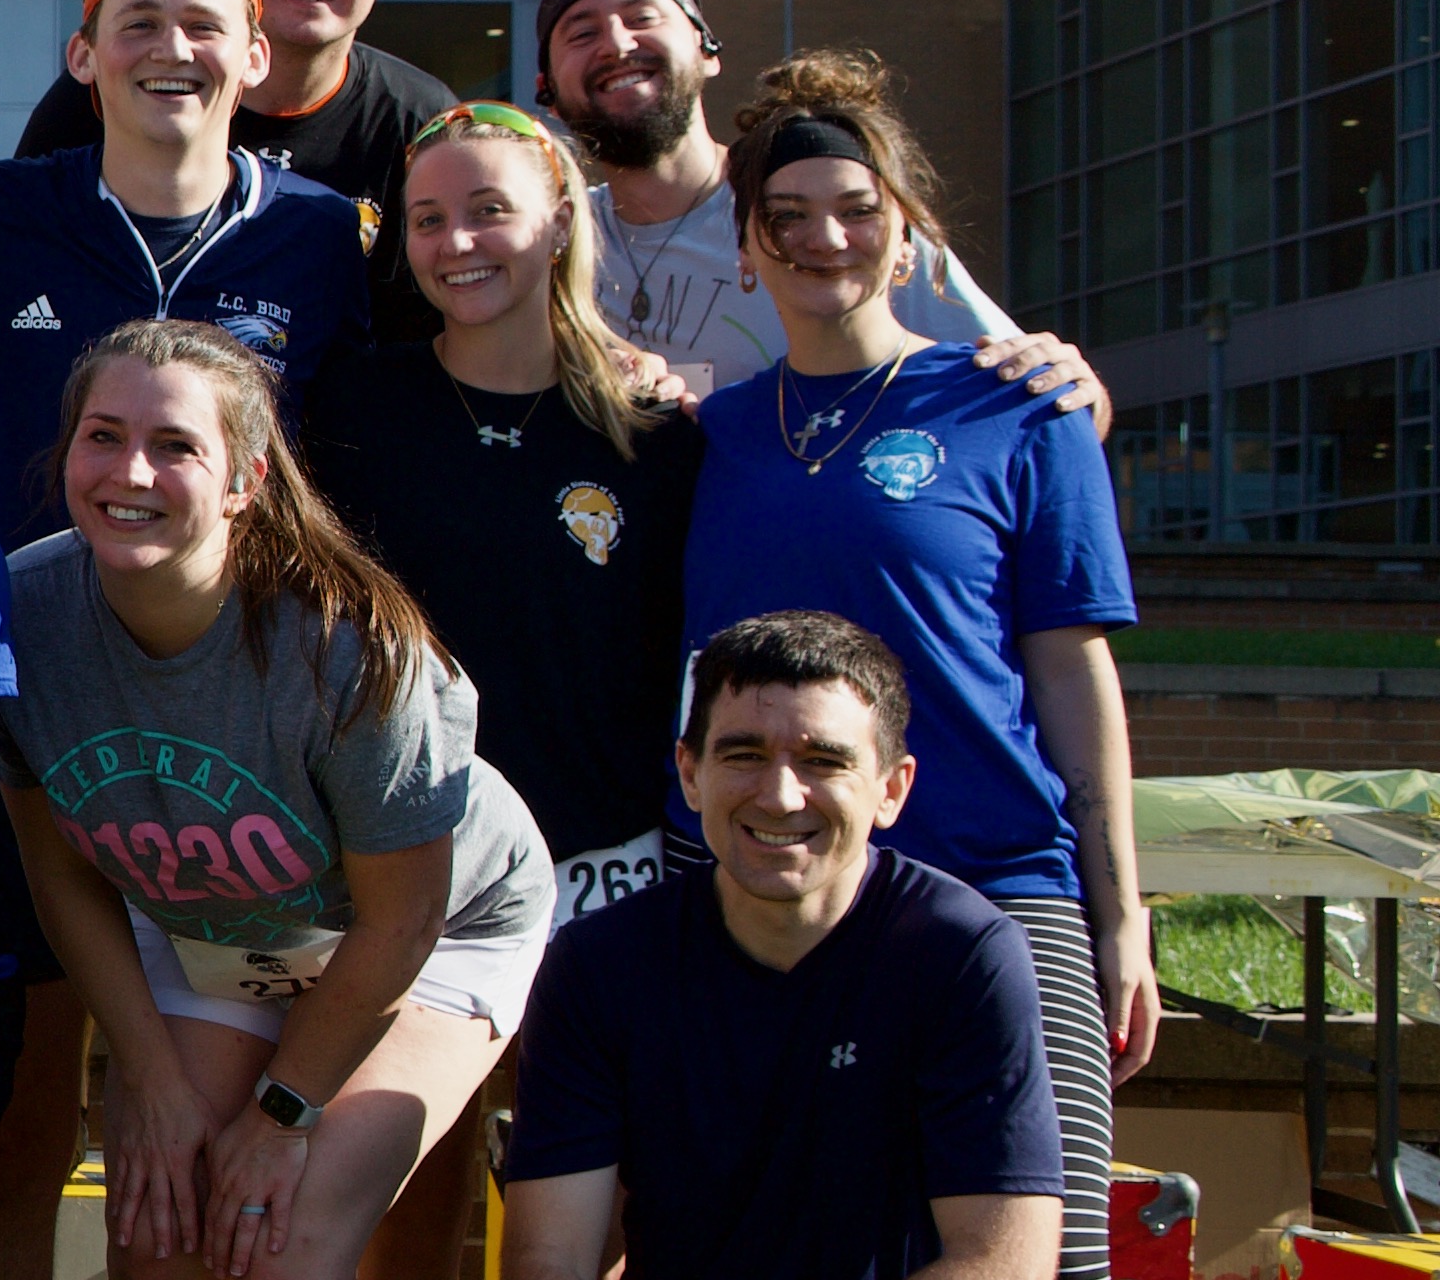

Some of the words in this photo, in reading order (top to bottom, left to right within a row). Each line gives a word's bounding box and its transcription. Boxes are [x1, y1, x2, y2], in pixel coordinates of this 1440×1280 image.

[11, 314, 62, 331] adidas
[217, 292, 247, 312] L.C.
[256, 300, 292, 324] BIRD
[881, 428, 915, 437] Sisters
[926, 434, 939, 446] the
[937, 446, 946, 464] Poor
[555, 486, 571, 503] Little
[570, 481, 598, 489] Sisters
[599, 486, 609, 494] of
[608, 492, 619, 505] the
[616, 507, 625, 525] Poor
[239, 976, 320, 998] 27
